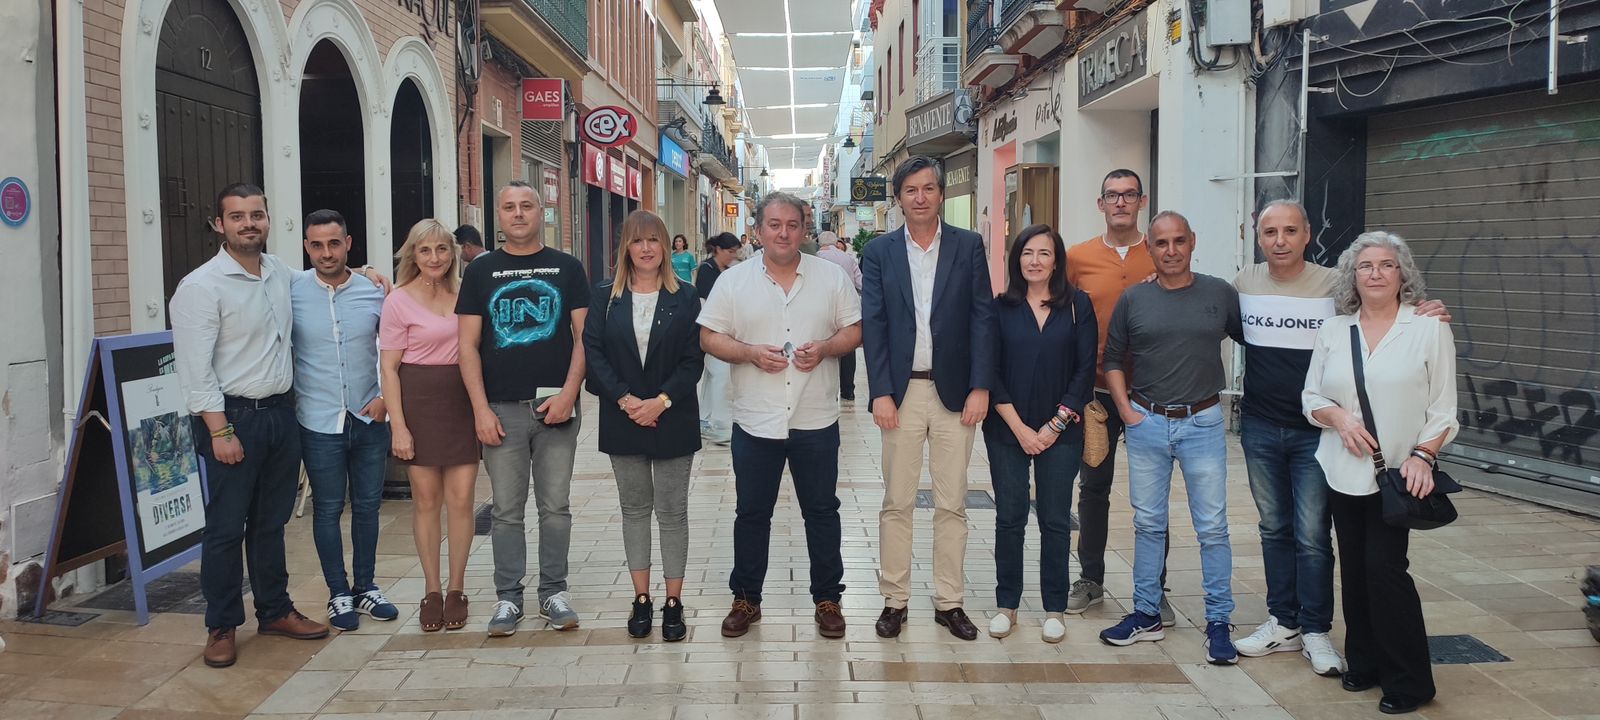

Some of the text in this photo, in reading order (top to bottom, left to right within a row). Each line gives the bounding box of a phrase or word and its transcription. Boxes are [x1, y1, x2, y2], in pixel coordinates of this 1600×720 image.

[200, 46, 213, 70] 12
[1079, 24, 1144, 97] TRIBECA
[524, 91, 560, 102] GAES
[909, 102, 951, 138] BENAVENTE
[946, 165, 970, 187] BENAVENTE
[499, 296, 550, 322] IN
[152, 494, 192, 525] DIVERSA
